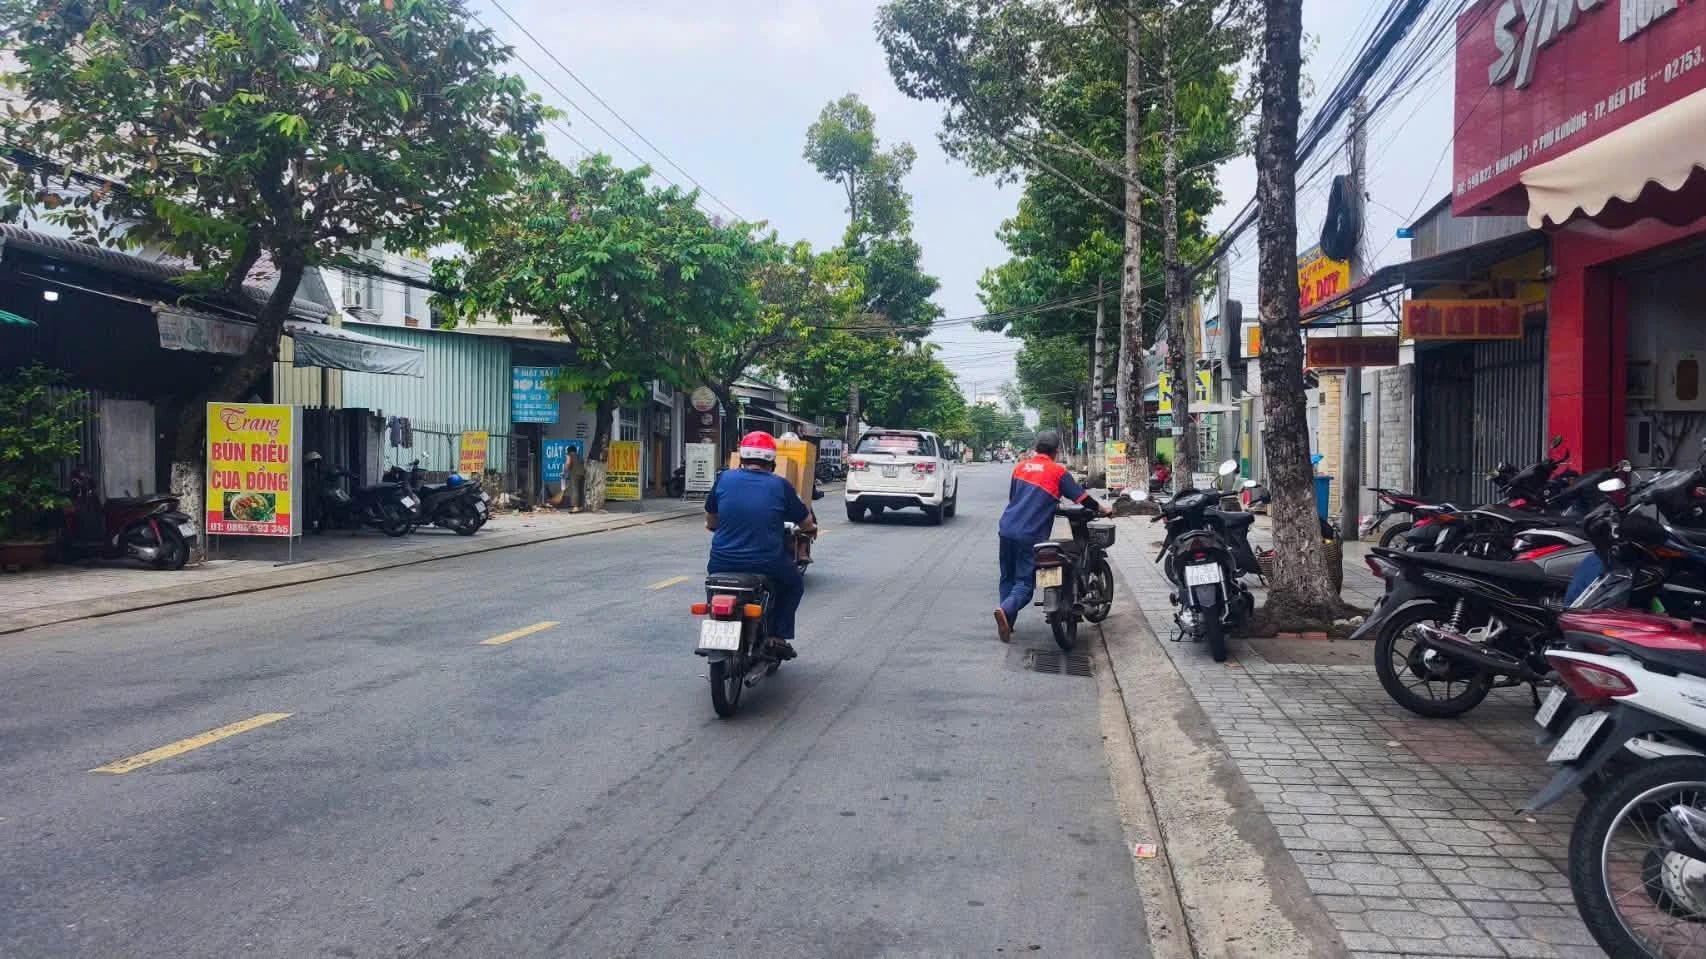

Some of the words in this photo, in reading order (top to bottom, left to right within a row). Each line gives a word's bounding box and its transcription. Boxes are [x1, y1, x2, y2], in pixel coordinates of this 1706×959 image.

[1594, 99, 1606, 121] TP.
[1628, 76, 1647, 103] TRE
[220, 408, 280, 437] Trang
[212, 439, 246, 461] BÚN
[251, 440, 288, 463] RIÊU
[212, 470, 241, 490] CUA
[246, 465, 288, 491] ĐỒNG
